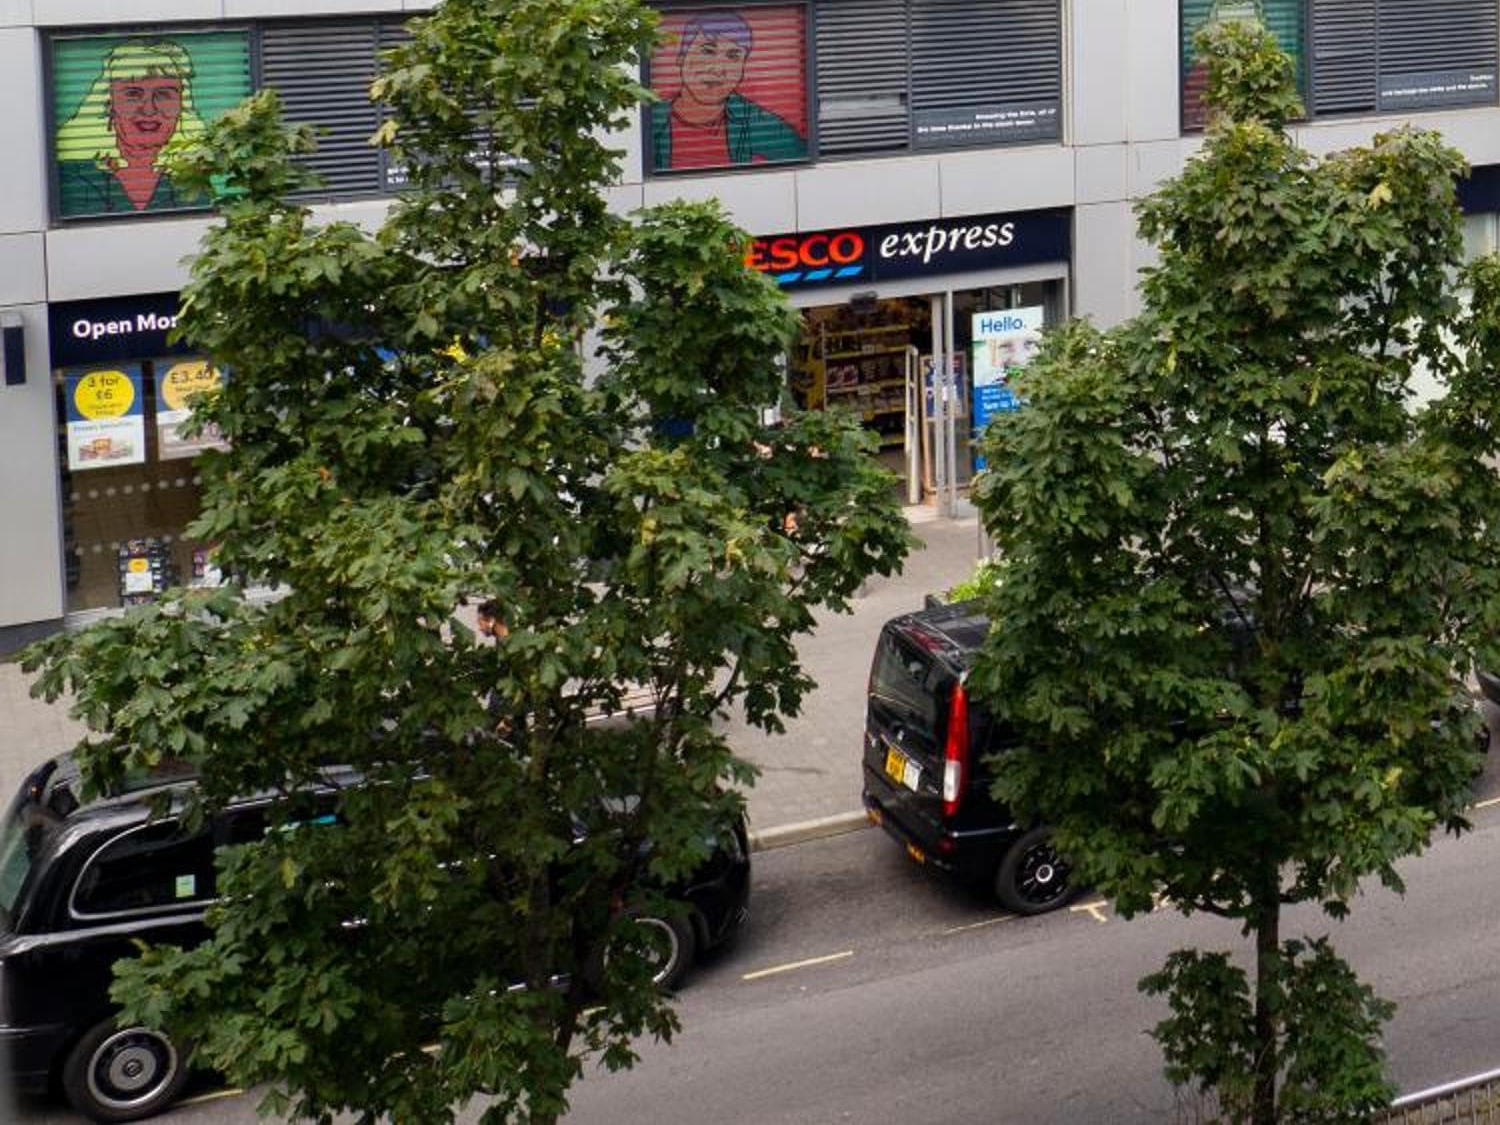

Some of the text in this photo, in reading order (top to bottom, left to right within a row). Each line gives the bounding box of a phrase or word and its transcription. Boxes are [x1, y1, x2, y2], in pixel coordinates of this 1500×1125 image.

[743, 222, 1015, 270] ESCO express
[72, 319, 132, 340] Open
